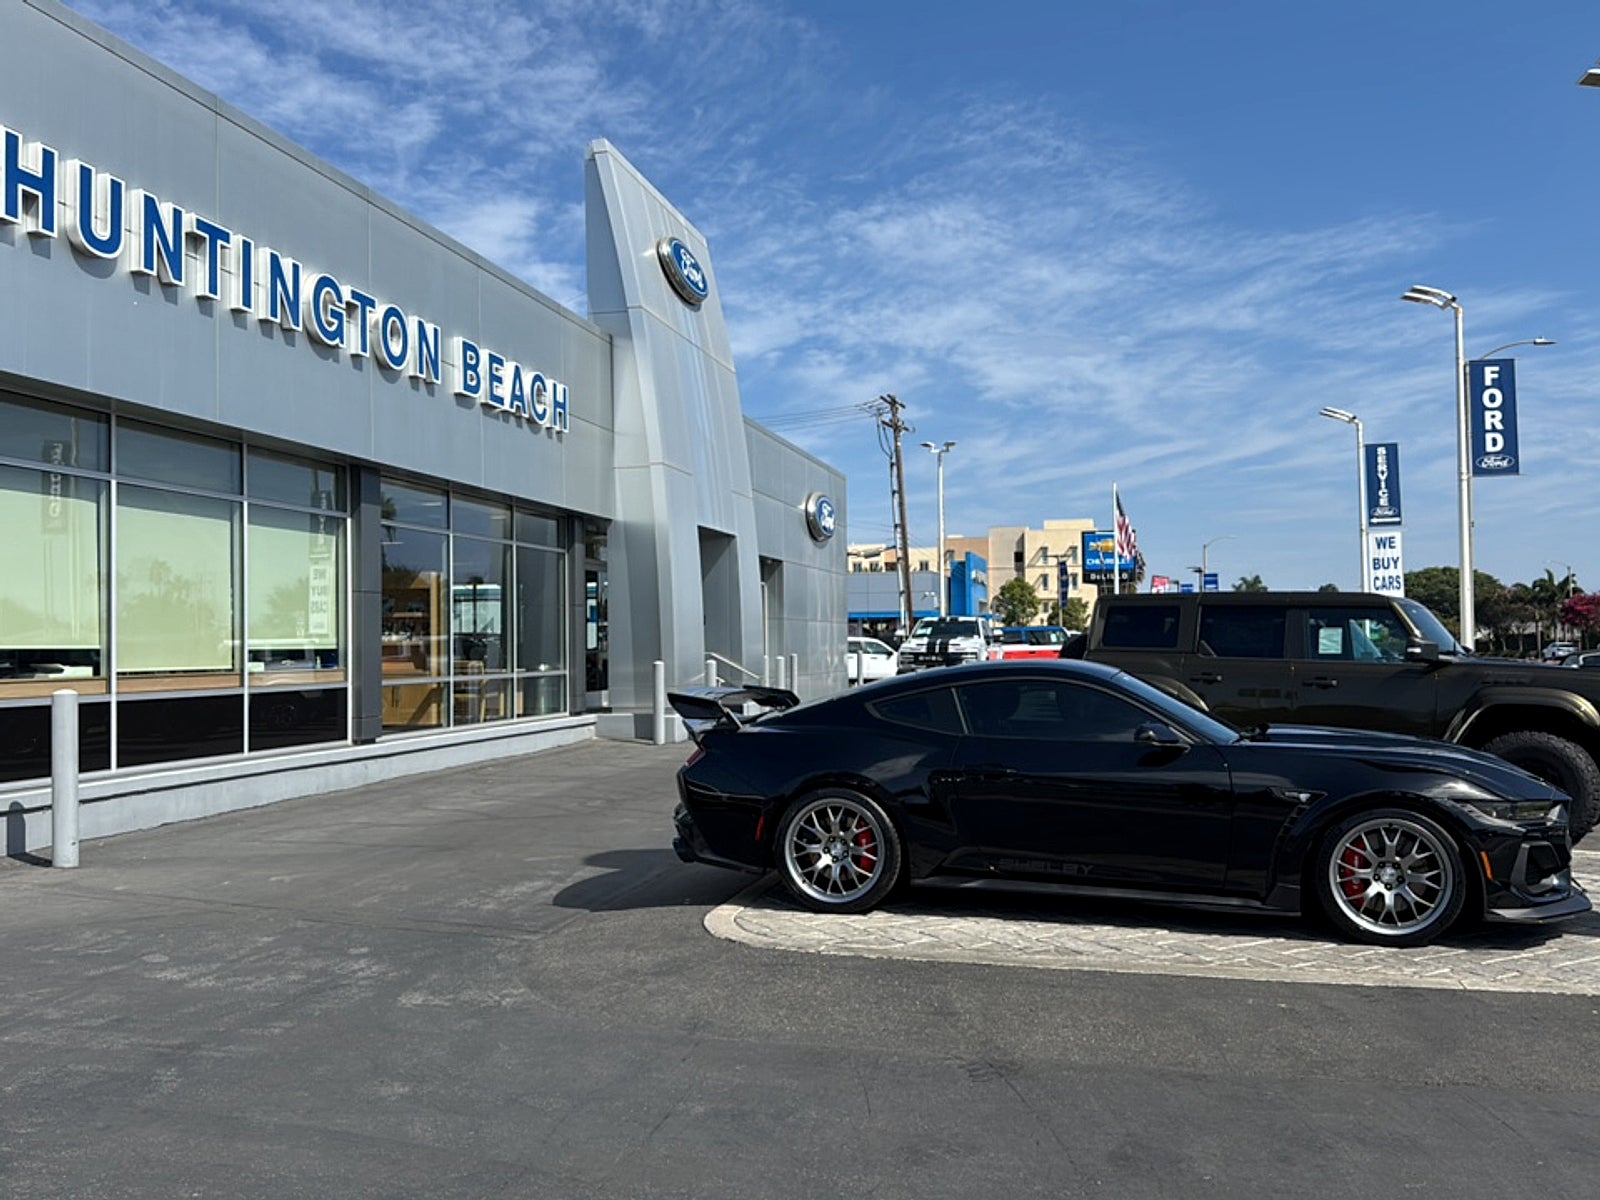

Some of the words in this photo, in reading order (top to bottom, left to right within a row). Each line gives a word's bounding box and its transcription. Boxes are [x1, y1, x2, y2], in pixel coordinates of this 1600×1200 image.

[680, 248, 704, 290] Ford
[1, 125, 442, 384] HUNTINGTON
[453, 336, 569, 433] BEACH
[1482, 366, 1504, 453] FORD
[1478, 455, 1512, 469] Ford
[1376, 446, 1389, 506] SERVICE
[1375, 536, 1396, 549] WE
[1372, 557, 1399, 570] BUY
[1090, 572, 1128, 580] DeLILO
[1373, 575, 1401, 590] CARS
